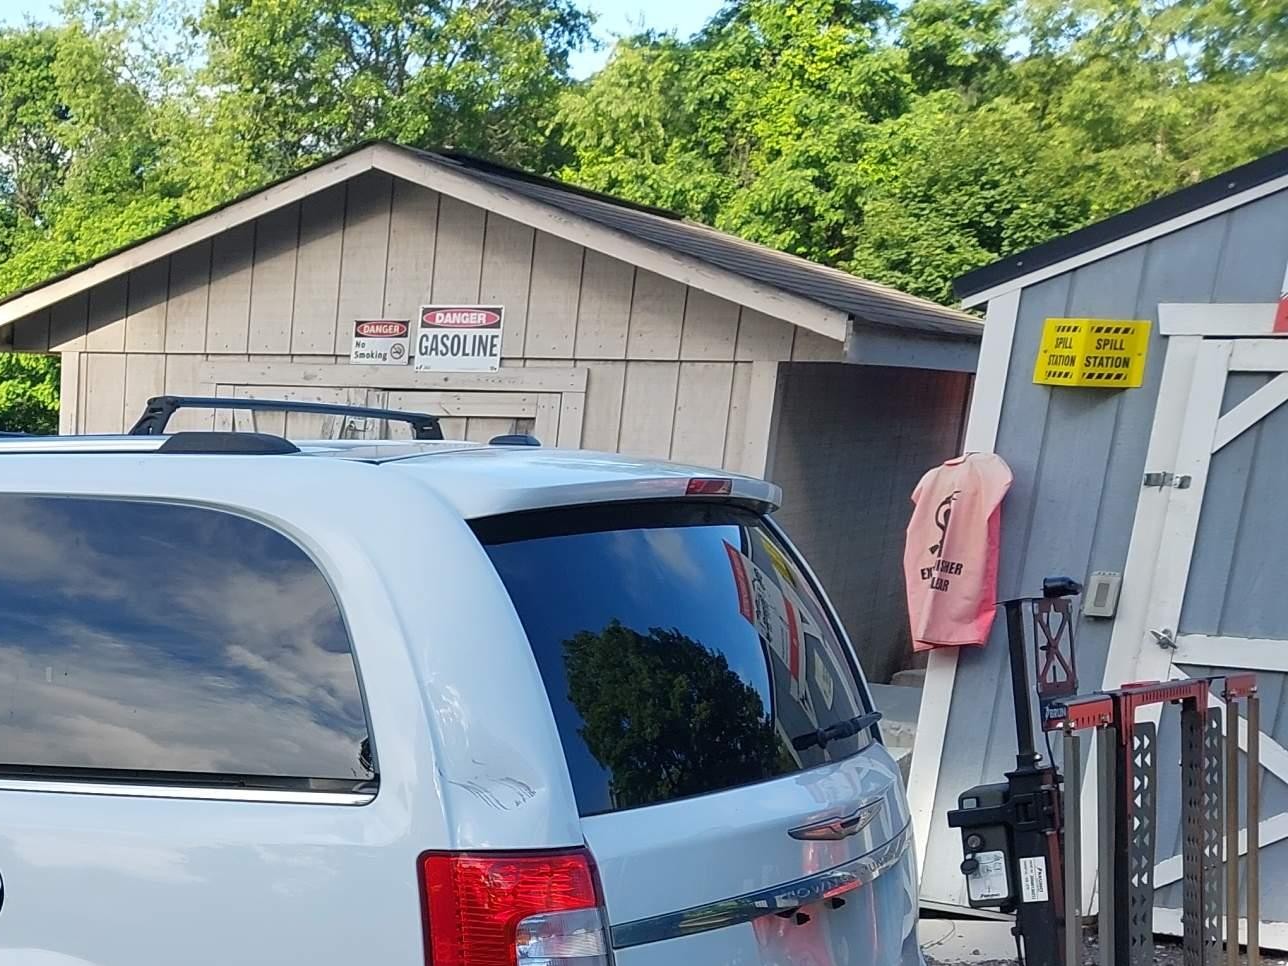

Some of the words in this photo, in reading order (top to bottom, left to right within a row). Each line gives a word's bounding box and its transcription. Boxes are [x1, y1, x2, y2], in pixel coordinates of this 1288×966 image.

[435, 312, 487, 324] DANGER
[363, 324, 400, 334] DANGER
[355, 341, 366, 349] No
[419, 333, 499, 357] GASOLINE
[1054, 336, 1073, 349] SPILL
[1095, 338, 1126, 351] SPILL
[353, 350, 388, 362] Smoking
[1047, 354, 1076, 367] STATION
[1084, 355, 1130, 369] STATION
